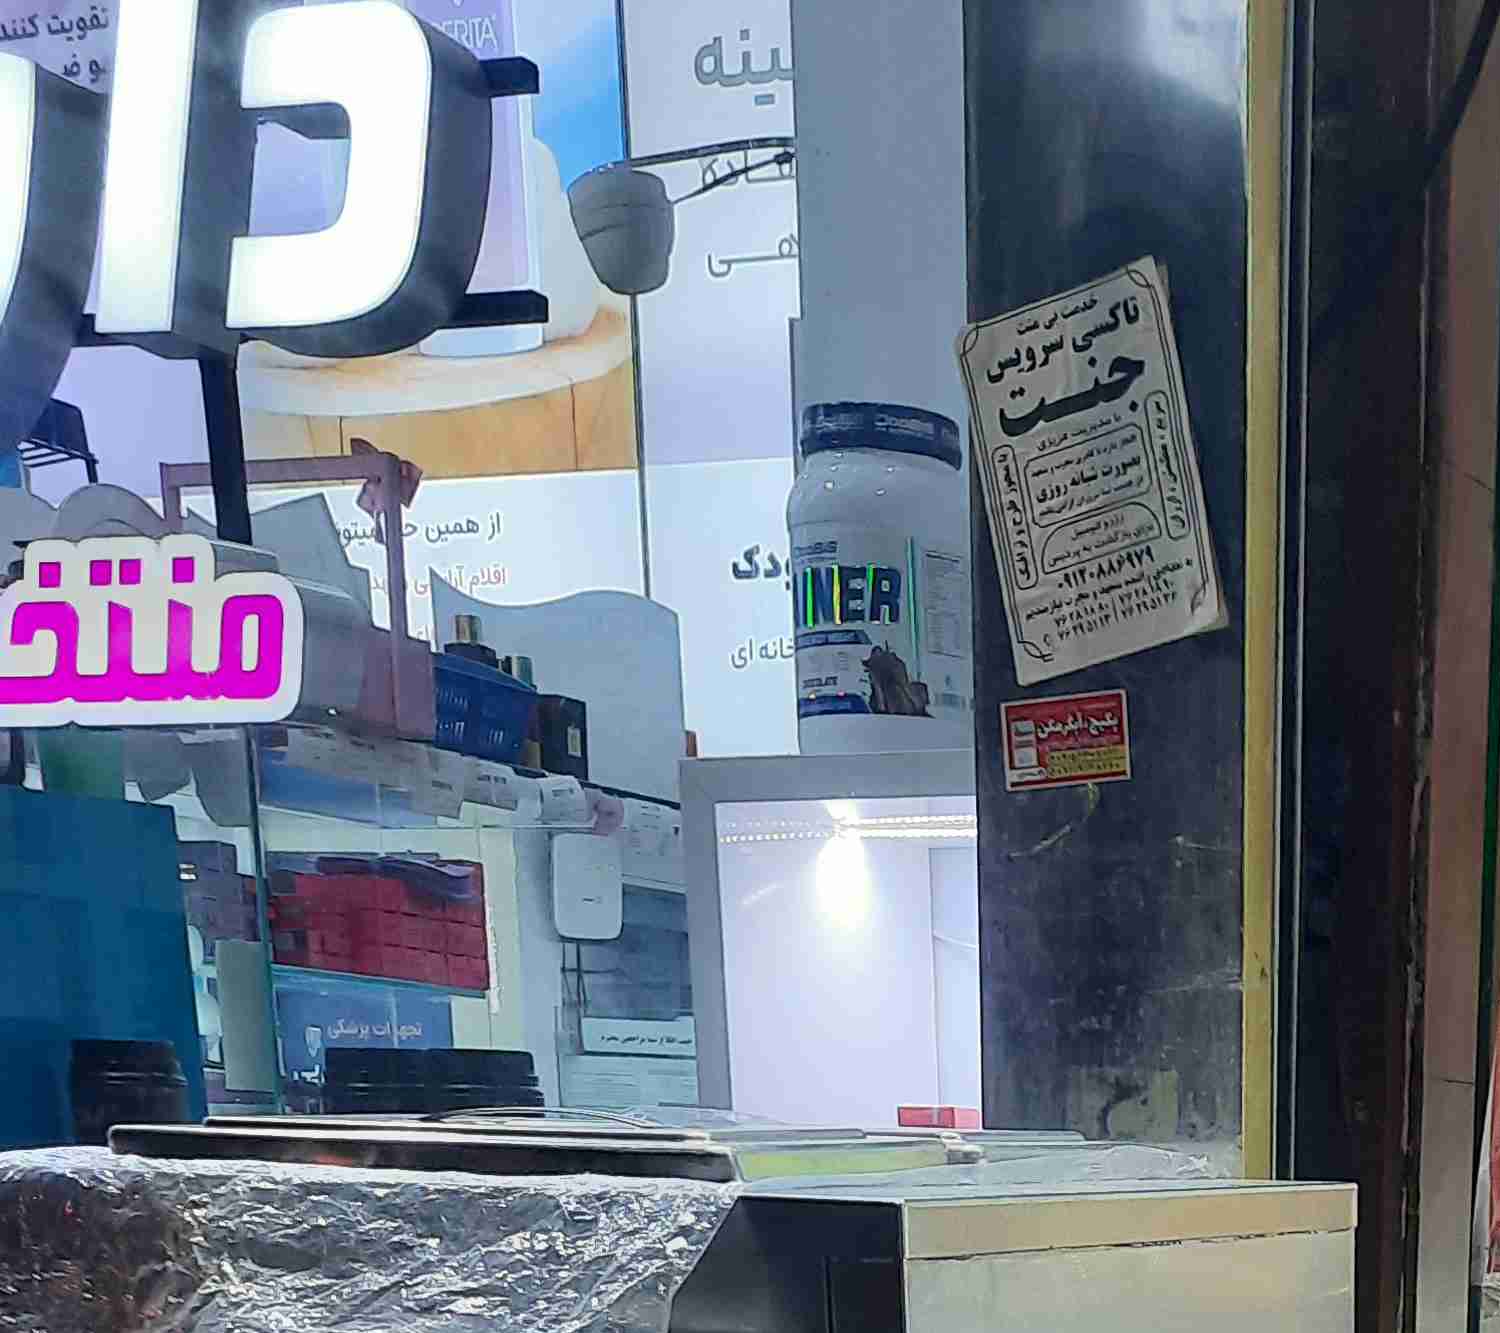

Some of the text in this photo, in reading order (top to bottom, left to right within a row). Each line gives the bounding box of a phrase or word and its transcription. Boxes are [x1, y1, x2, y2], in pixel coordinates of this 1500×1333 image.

[0, 13, 40, 41] کنند
[441, 15, 499, 49] ERITA
[694, 28, 795, 107] ینه
[0, 0, 432, 333] دا
[987, 296, 1140, 384] تاکسی سرویس
[999, 354, 1146, 438] جنت
[1036, 483, 1069, 504] روزی
[425, 517, 480, 543] همین
[487, 511, 501, 542] از
[0, 556, 284, 704] منتخ
